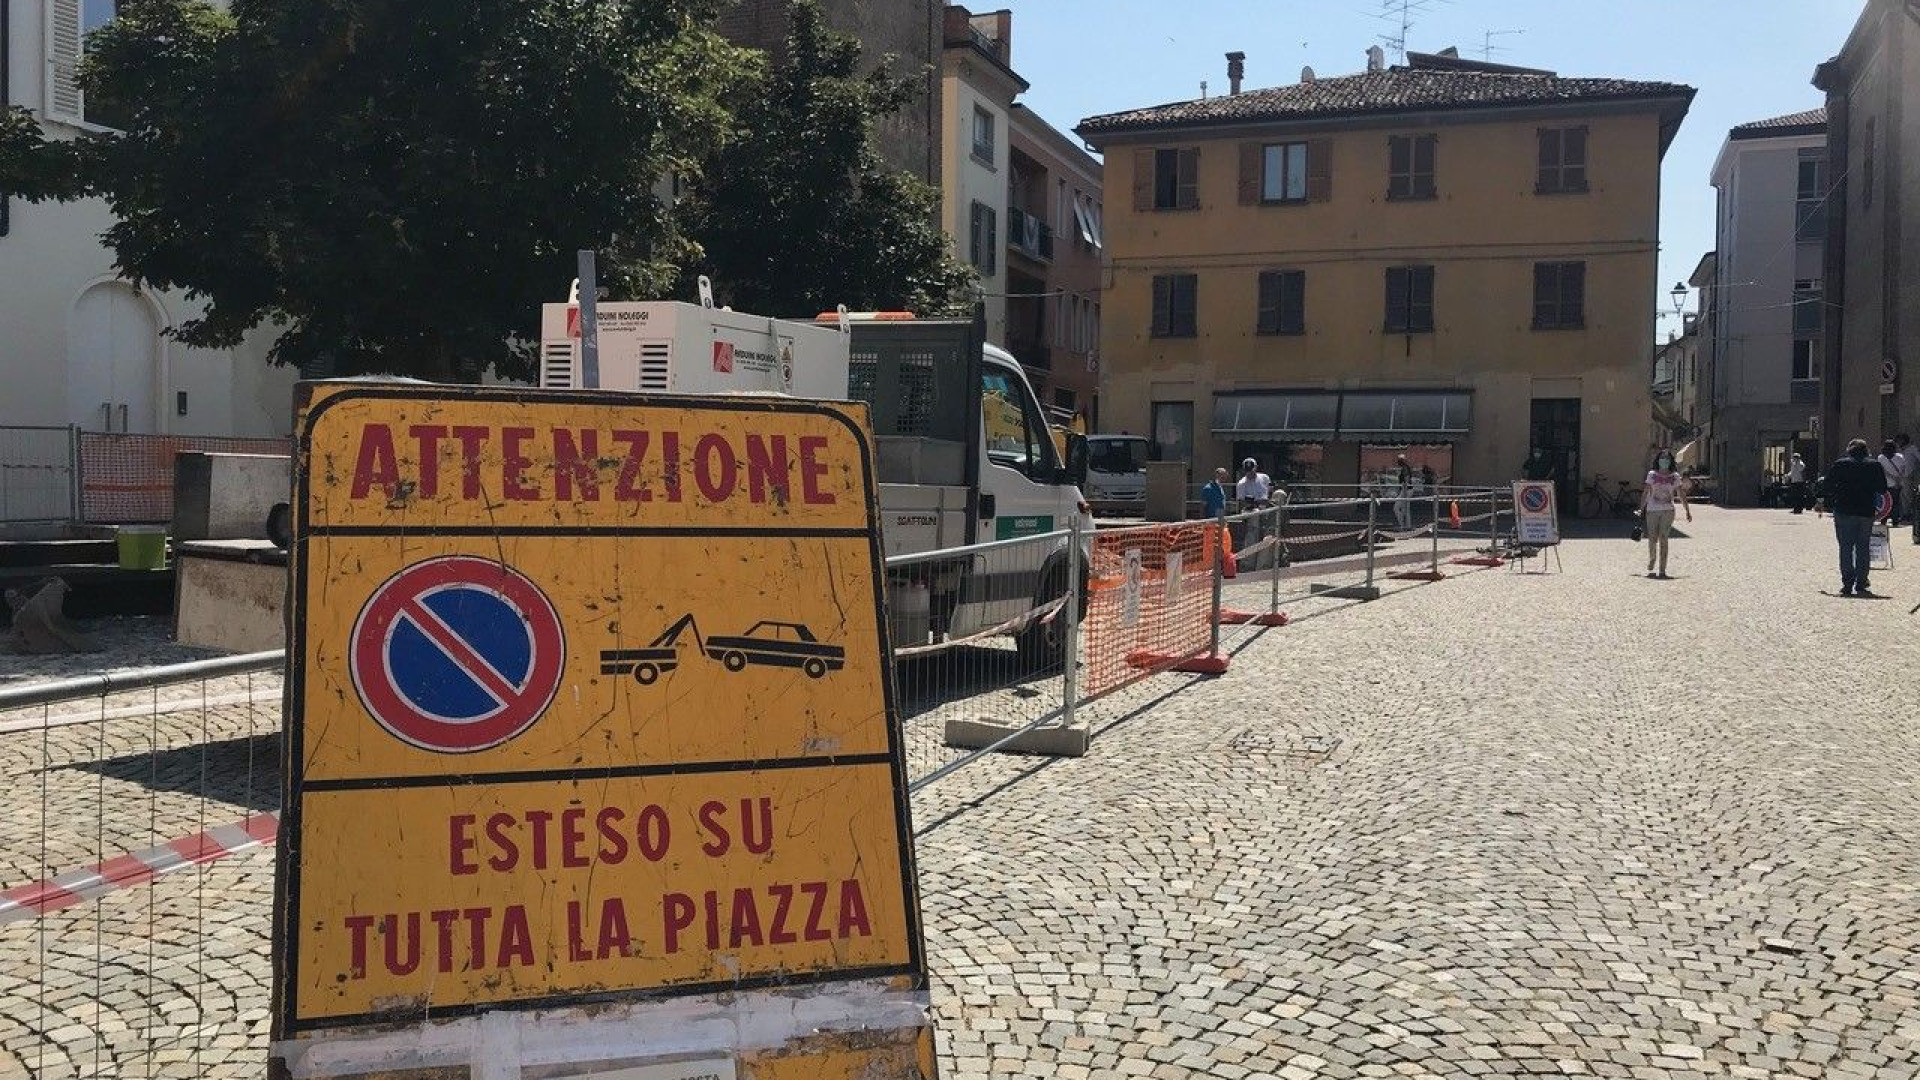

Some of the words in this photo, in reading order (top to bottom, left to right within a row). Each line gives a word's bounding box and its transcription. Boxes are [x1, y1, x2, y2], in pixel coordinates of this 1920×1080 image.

[350, 423, 837, 505] ATTENZIONE
[449, 804, 671, 876] ESTESO
[699, 796, 775, 859] SU
[346, 904, 535, 980] TUTTA
[567, 896, 632, 963] LA
[663, 878, 873, 955] PIAZZA
